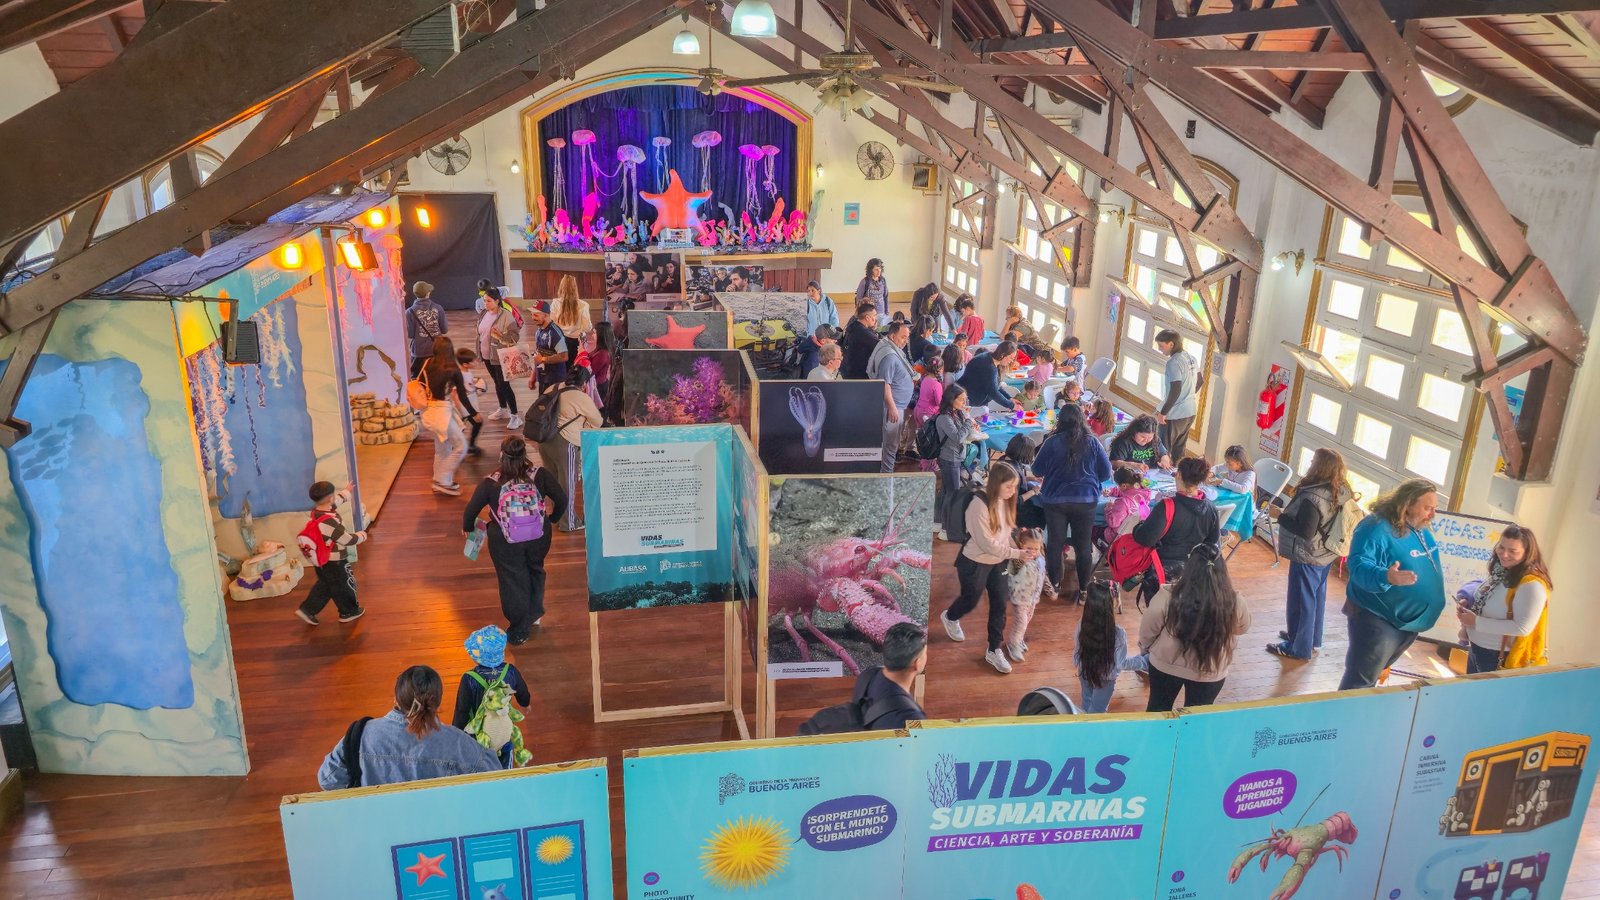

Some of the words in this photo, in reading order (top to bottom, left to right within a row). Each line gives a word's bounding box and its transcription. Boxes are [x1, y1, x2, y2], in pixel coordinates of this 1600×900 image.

[1278, 736, 1312, 746] BUENOS
[1313, 733, 1337, 741] AIRES
[749, 782, 790, 793] BUENOS
[792, 781, 820, 790] AIRES
[954, 754, 1130, 802] VIDAS
[1238, 779, 1274, 792] ¡VAMOS
[1275, 777, 1282, 786] A
[1234, 787, 1284, 803] APRENDER
[929, 796, 1148, 831] SUBMARINAS
[1236, 796, 1283, 814] JUGANDO!
[807, 805, 887, 825] ¡SORPRENDETE
[809, 824, 832, 834] CON
[834, 822, 846, 831] EL
[849, 815, 889, 829] MUNDO
[816, 826, 883, 843] SUBMARINO!
[934, 834, 995, 849] CIENCIA,
[1000, 832, 1036, 844] ARTE
[1041, 832, 1050, 842] Y
[1053, 825, 1135, 842] SOBERANÍA
